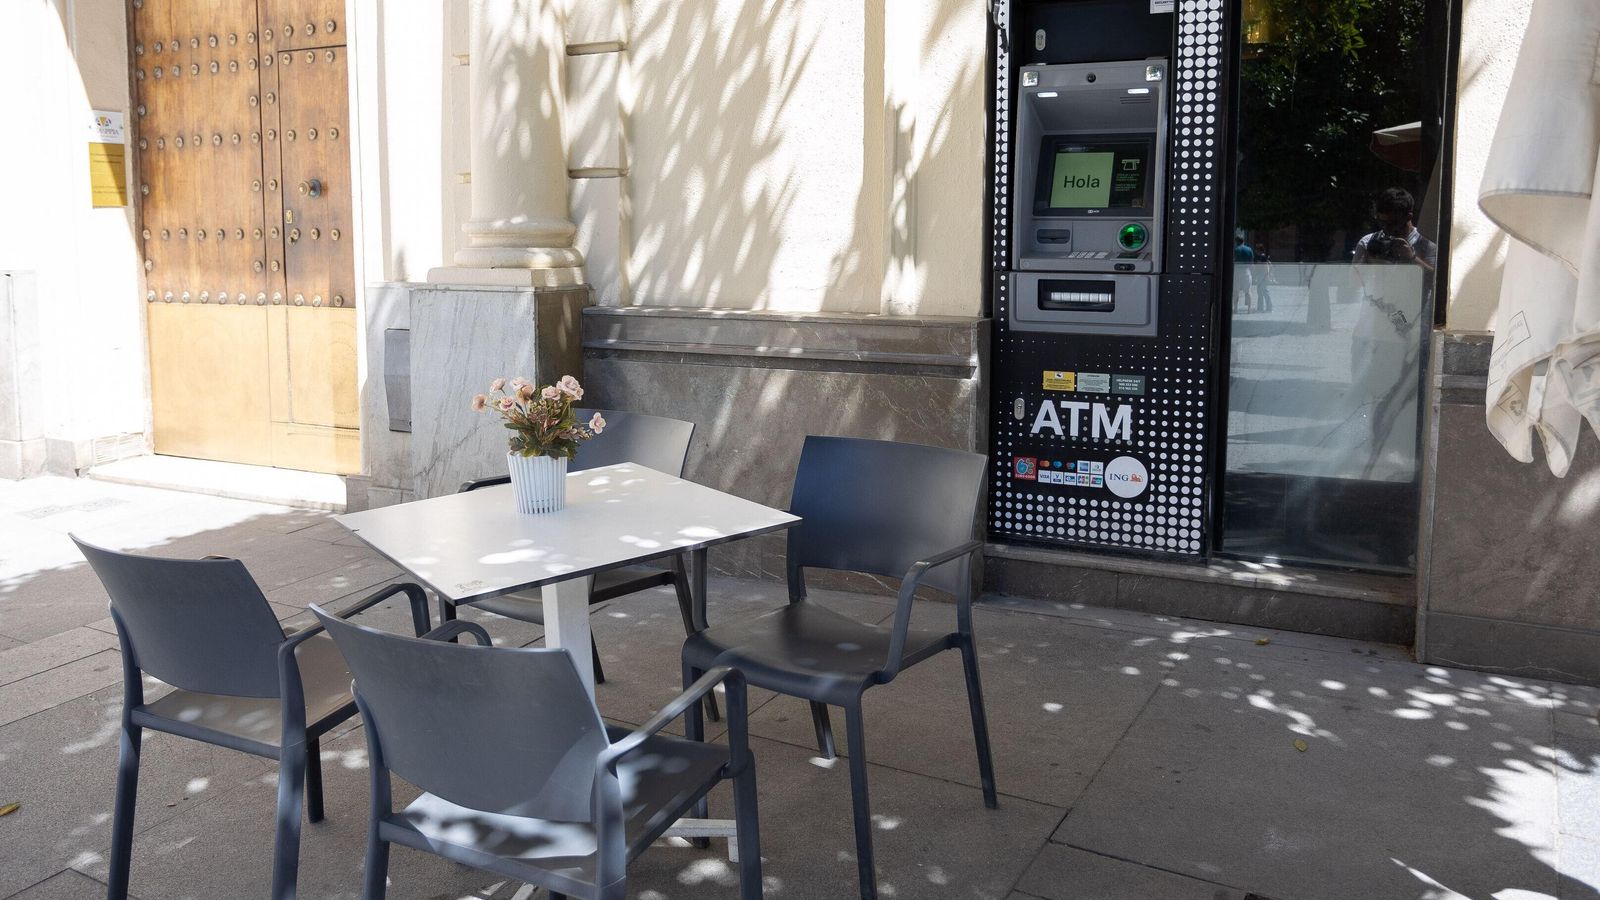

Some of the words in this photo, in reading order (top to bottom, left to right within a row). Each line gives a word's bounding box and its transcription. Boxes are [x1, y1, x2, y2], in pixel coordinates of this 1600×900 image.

[1063, 174, 1100, 189] Hola
[1031, 400, 1131, 440] ATM
[1109, 473, 1129, 481] ING
